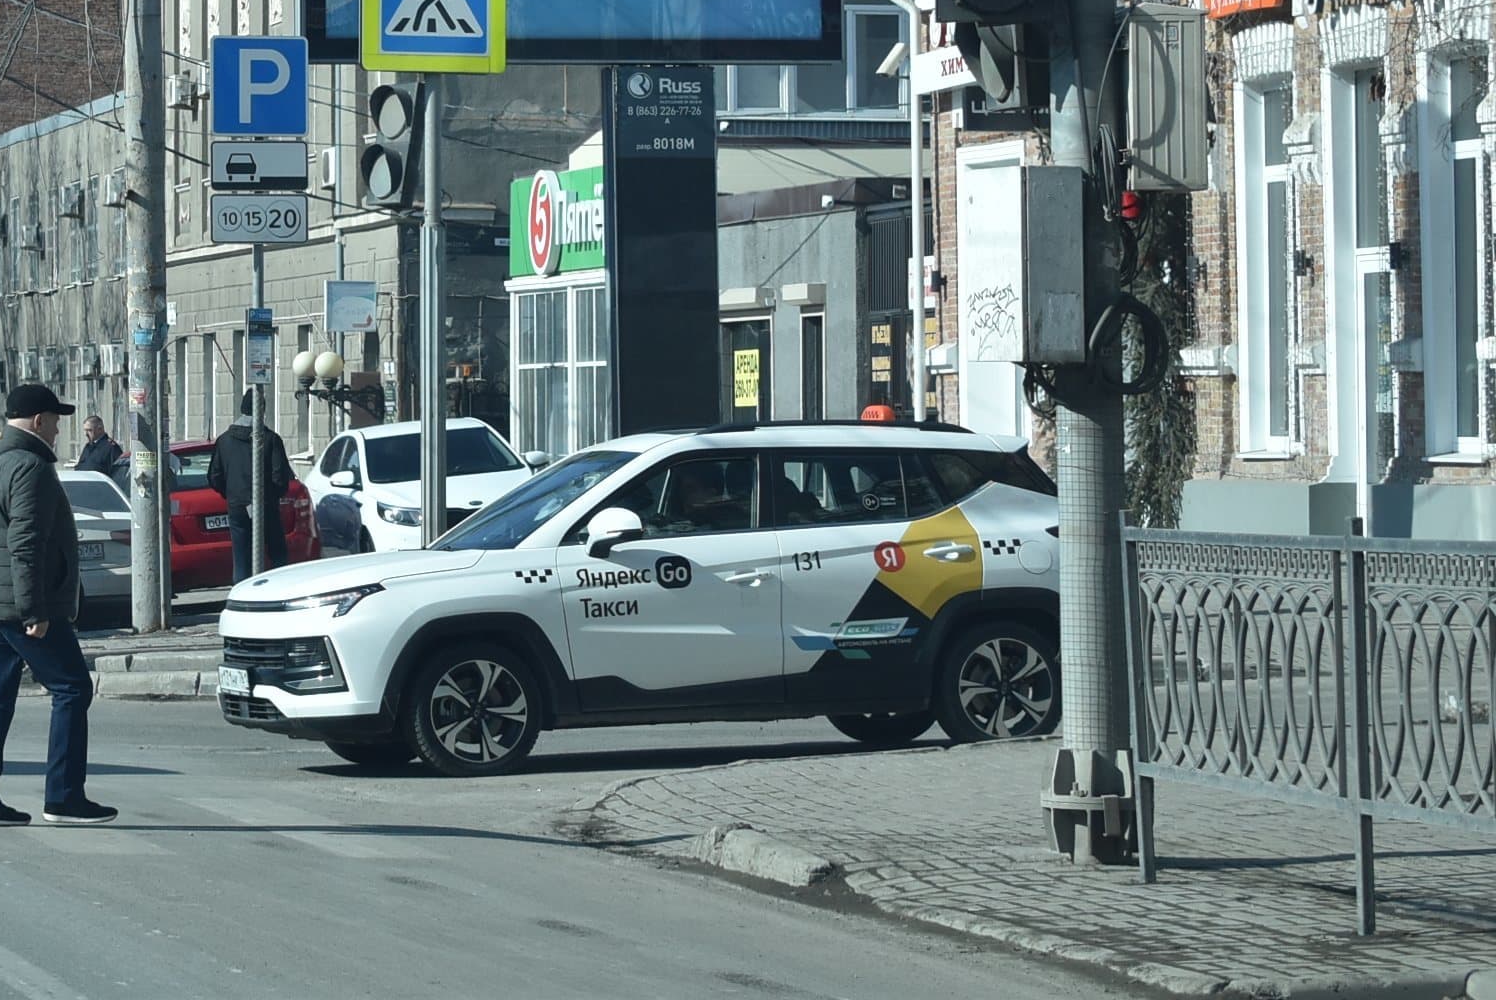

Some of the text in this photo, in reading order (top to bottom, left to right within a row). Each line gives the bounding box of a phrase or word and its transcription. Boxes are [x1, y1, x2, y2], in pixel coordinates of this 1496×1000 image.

[941, 57, 964, 77] ХИМ
[239, 49, 291, 124] P
[659, 78, 702, 94] Russ
[660, 106, 702, 116] 226-77-26
[221, 209, 297, 229] 10 15 20
[555, 184, 604, 247] Пятё
[736, 354, 757, 374] АРЕНДА
[792, 551, 821, 571] 131
[881, 547, 899, 568] Я
[576, 562, 687, 588] Яндекс Go
[579, 598, 639, 618] Такси
